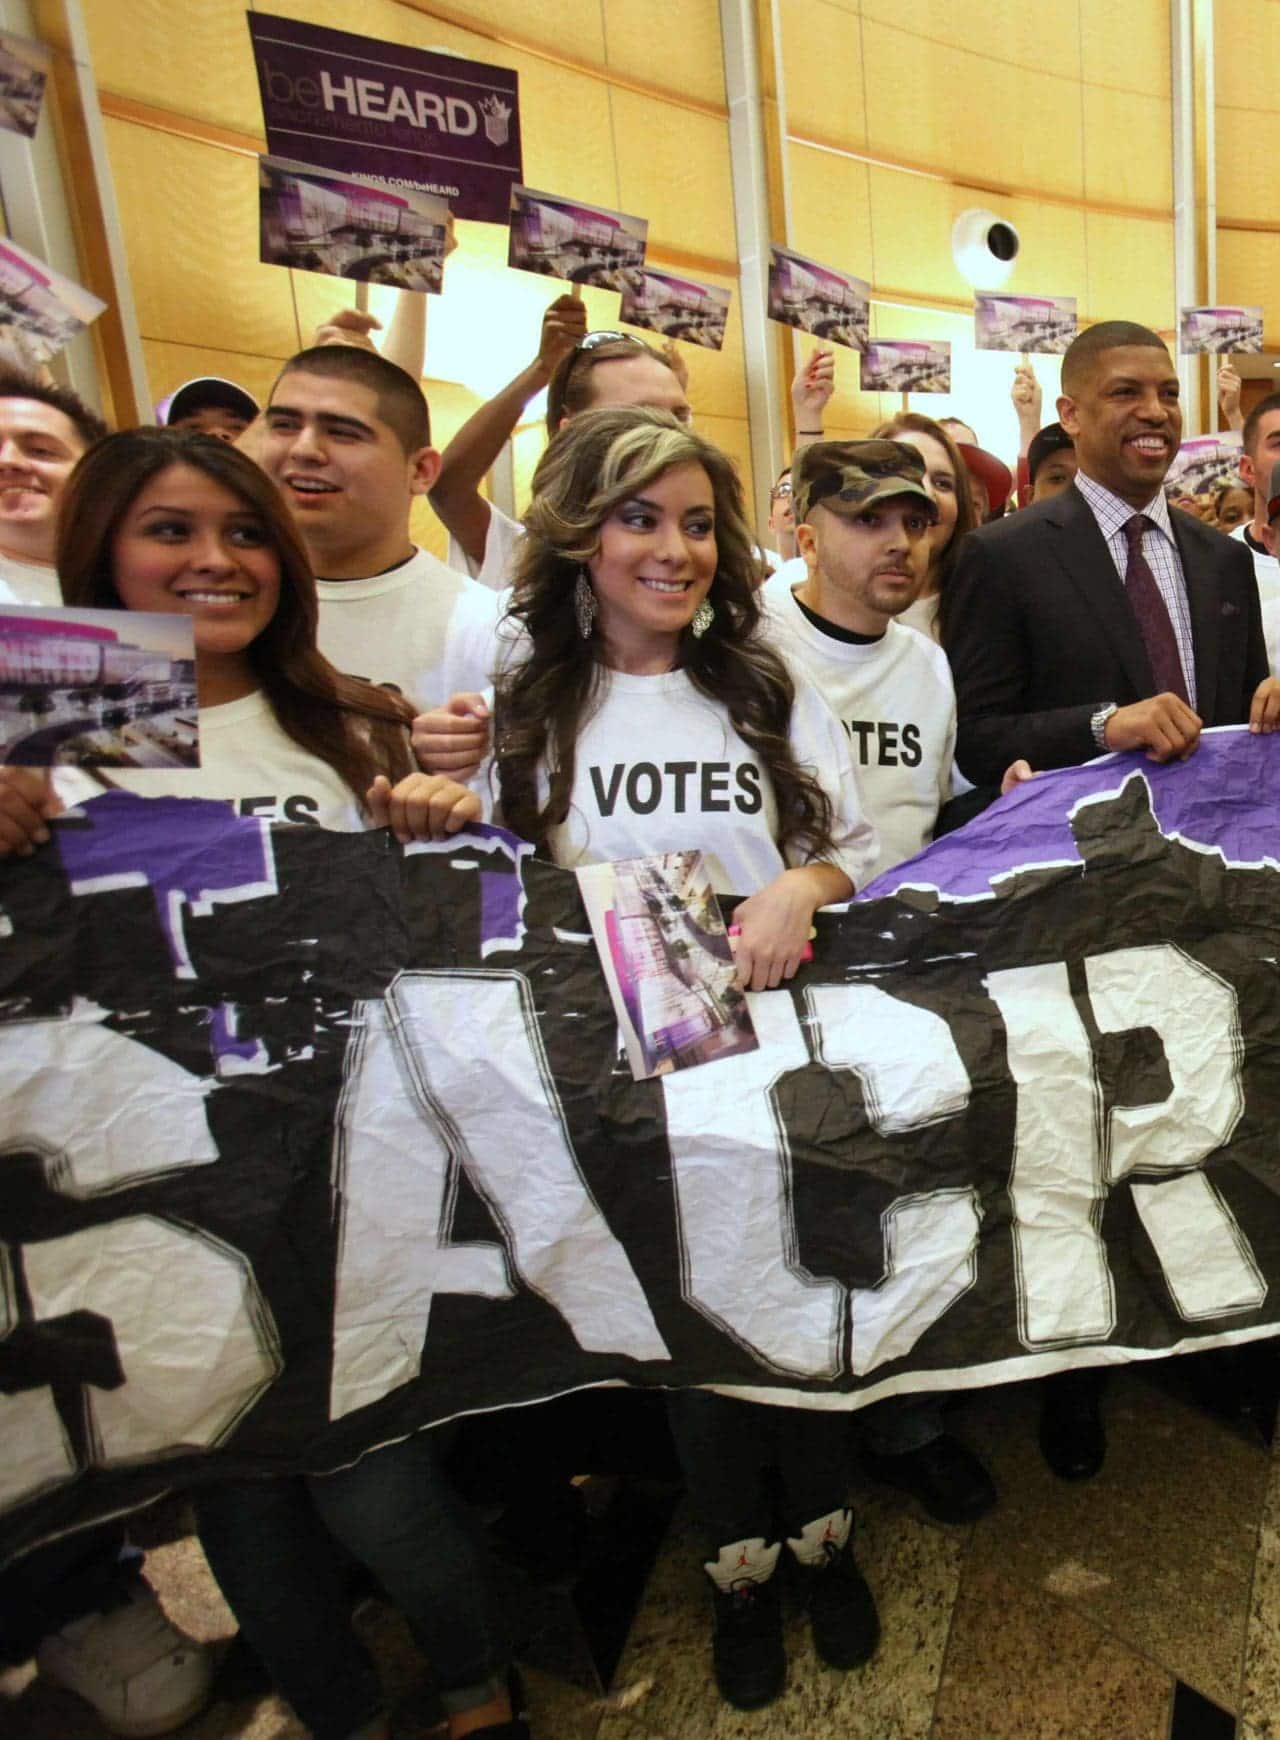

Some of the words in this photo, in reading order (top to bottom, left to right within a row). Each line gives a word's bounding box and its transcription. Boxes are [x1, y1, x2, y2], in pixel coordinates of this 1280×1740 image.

[840, 719, 923, 768] TES
[232, 794, 321, 825] ES
[588, 760, 763, 818] VOTES
